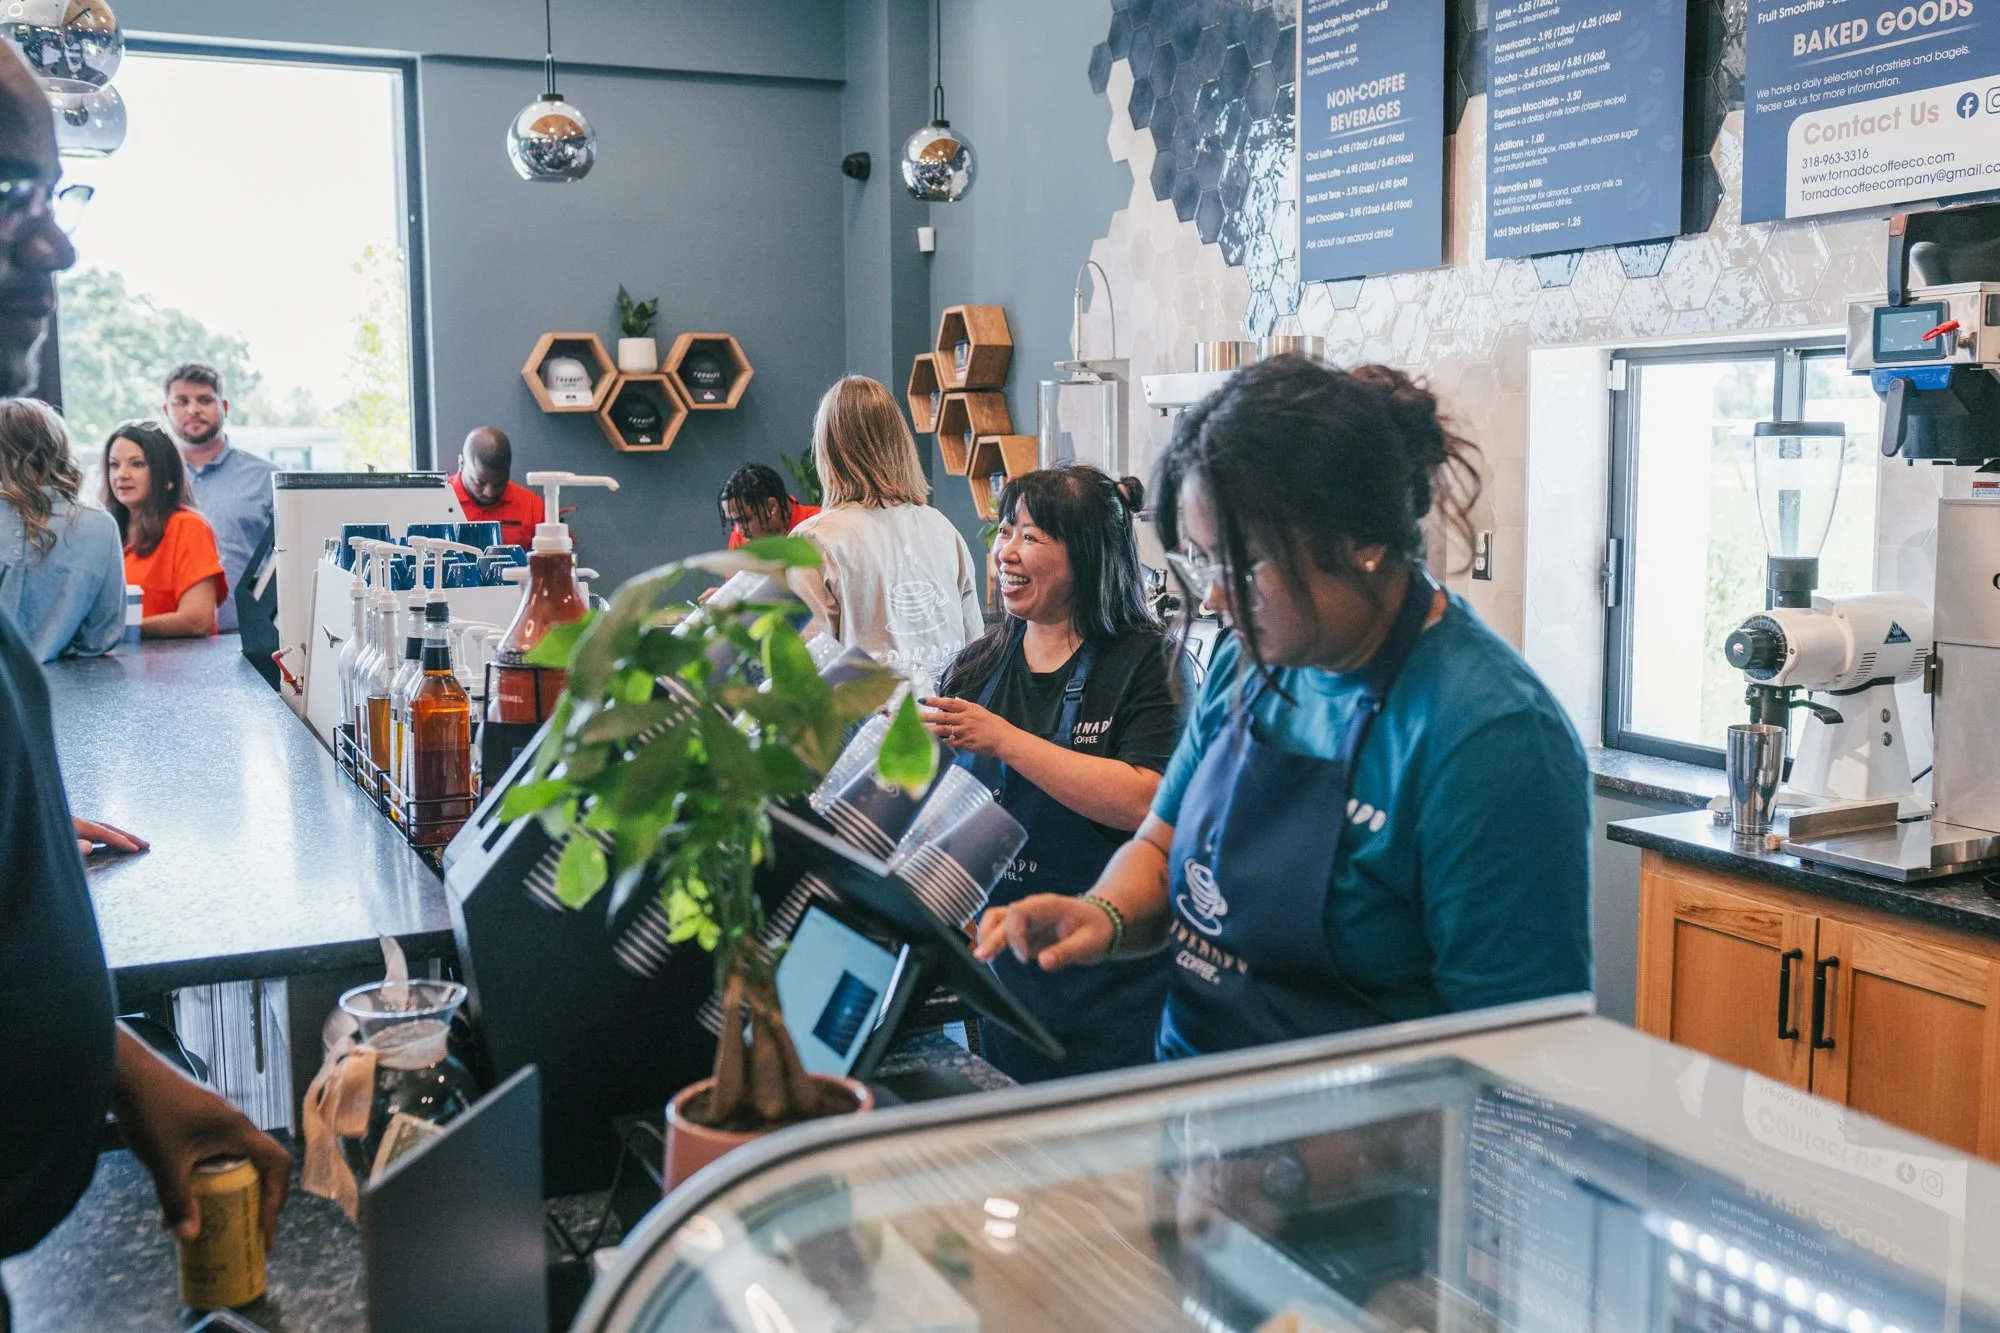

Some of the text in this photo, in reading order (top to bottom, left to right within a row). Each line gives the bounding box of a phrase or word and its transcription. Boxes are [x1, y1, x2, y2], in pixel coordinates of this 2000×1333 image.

[1496, 9, 1511, 20] Latte
[1758, 0, 1824, 24] Fruit Smoothie
[1495, 11, 1622, 53] Americano 3.95 (12oz) 4.25 (16oz)
[1793, 0, 1974, 56] BAKED GOODS
[1495, 53, 1515, 64] Double
[1546, 41, 1556, 50] hot
[1557, 38, 1574, 47] water
[1495, 49, 1605, 86] Mocha 5.45 (12oz) 5.85 (16oz)
[1756, 89, 1770, 99] We
[1771, 85, 1792, 96] have
[1801, 77, 1821, 89] daily
[1823, 70, 1863, 85] selection
[1864, 64, 1875, 76] of
[1876, 59, 1911, 76] pastries
[1913, 52, 1933, 66] and
[1935, 46, 1971, 61] bagels.
[1327, 73, 1405, 109] NON-COFFEE
[1536, 74, 1565, 88] chocolate
[1522, 97, 1559, 112] Macchiato
[1567, 90, 1582, 102] 3.50
[1564, 107, 1580, 115] foam
[1581, 101, 1602, 112] (classic
[1604, 95, 1626, 106] recipe)
[1756, 103, 1782, 113] Please
[1783, 97, 1798, 108] ask
[1809, 94, 1821, 103] for
[1823, 89, 1846, 100] more
[1847, 78, 1901, 95] information.
[1331, 100, 1401, 132] BEVERAGES
[1803, 102, 1940, 145] Contact Us
[1373, 137, 1385, 147] 5.45
[1386, 132, 1405, 145] (16oz)
[1494, 134, 1544, 152] Additions 1.00
[1559, 141, 1576, 151] made
[1577, 138, 1590, 147] with
[1590, 136, 1601, 145] real
[1620, 130, 1638, 139] sugar
[1381, 157, 1394, 167] 5.45
[1395, 153, 1414, 166] (16oz)
[1494, 165, 1505, 174] and
[1506, 161, 1525, 171] natural
[1802, 149, 1869, 170] 318-963-3316
[1802, 152, 1955, 185] www.tornadocoffeeco.com
[1380, 180, 1392, 190] 4.95
[1494, 179, 1543, 195] Alternative Milk
[1516, 195, 1536, 203] charge
[1602, 180, 1613, 188] milk
[1394, 198, 1413, 211] (16oz)
[1493, 217, 1581, 238] Add Shot of Espresso 1.25
[1306, 240, 1316, 250] Ask
[1317, 237, 1335, 248] about
[1346, 231, 1374, 243] seasonal
